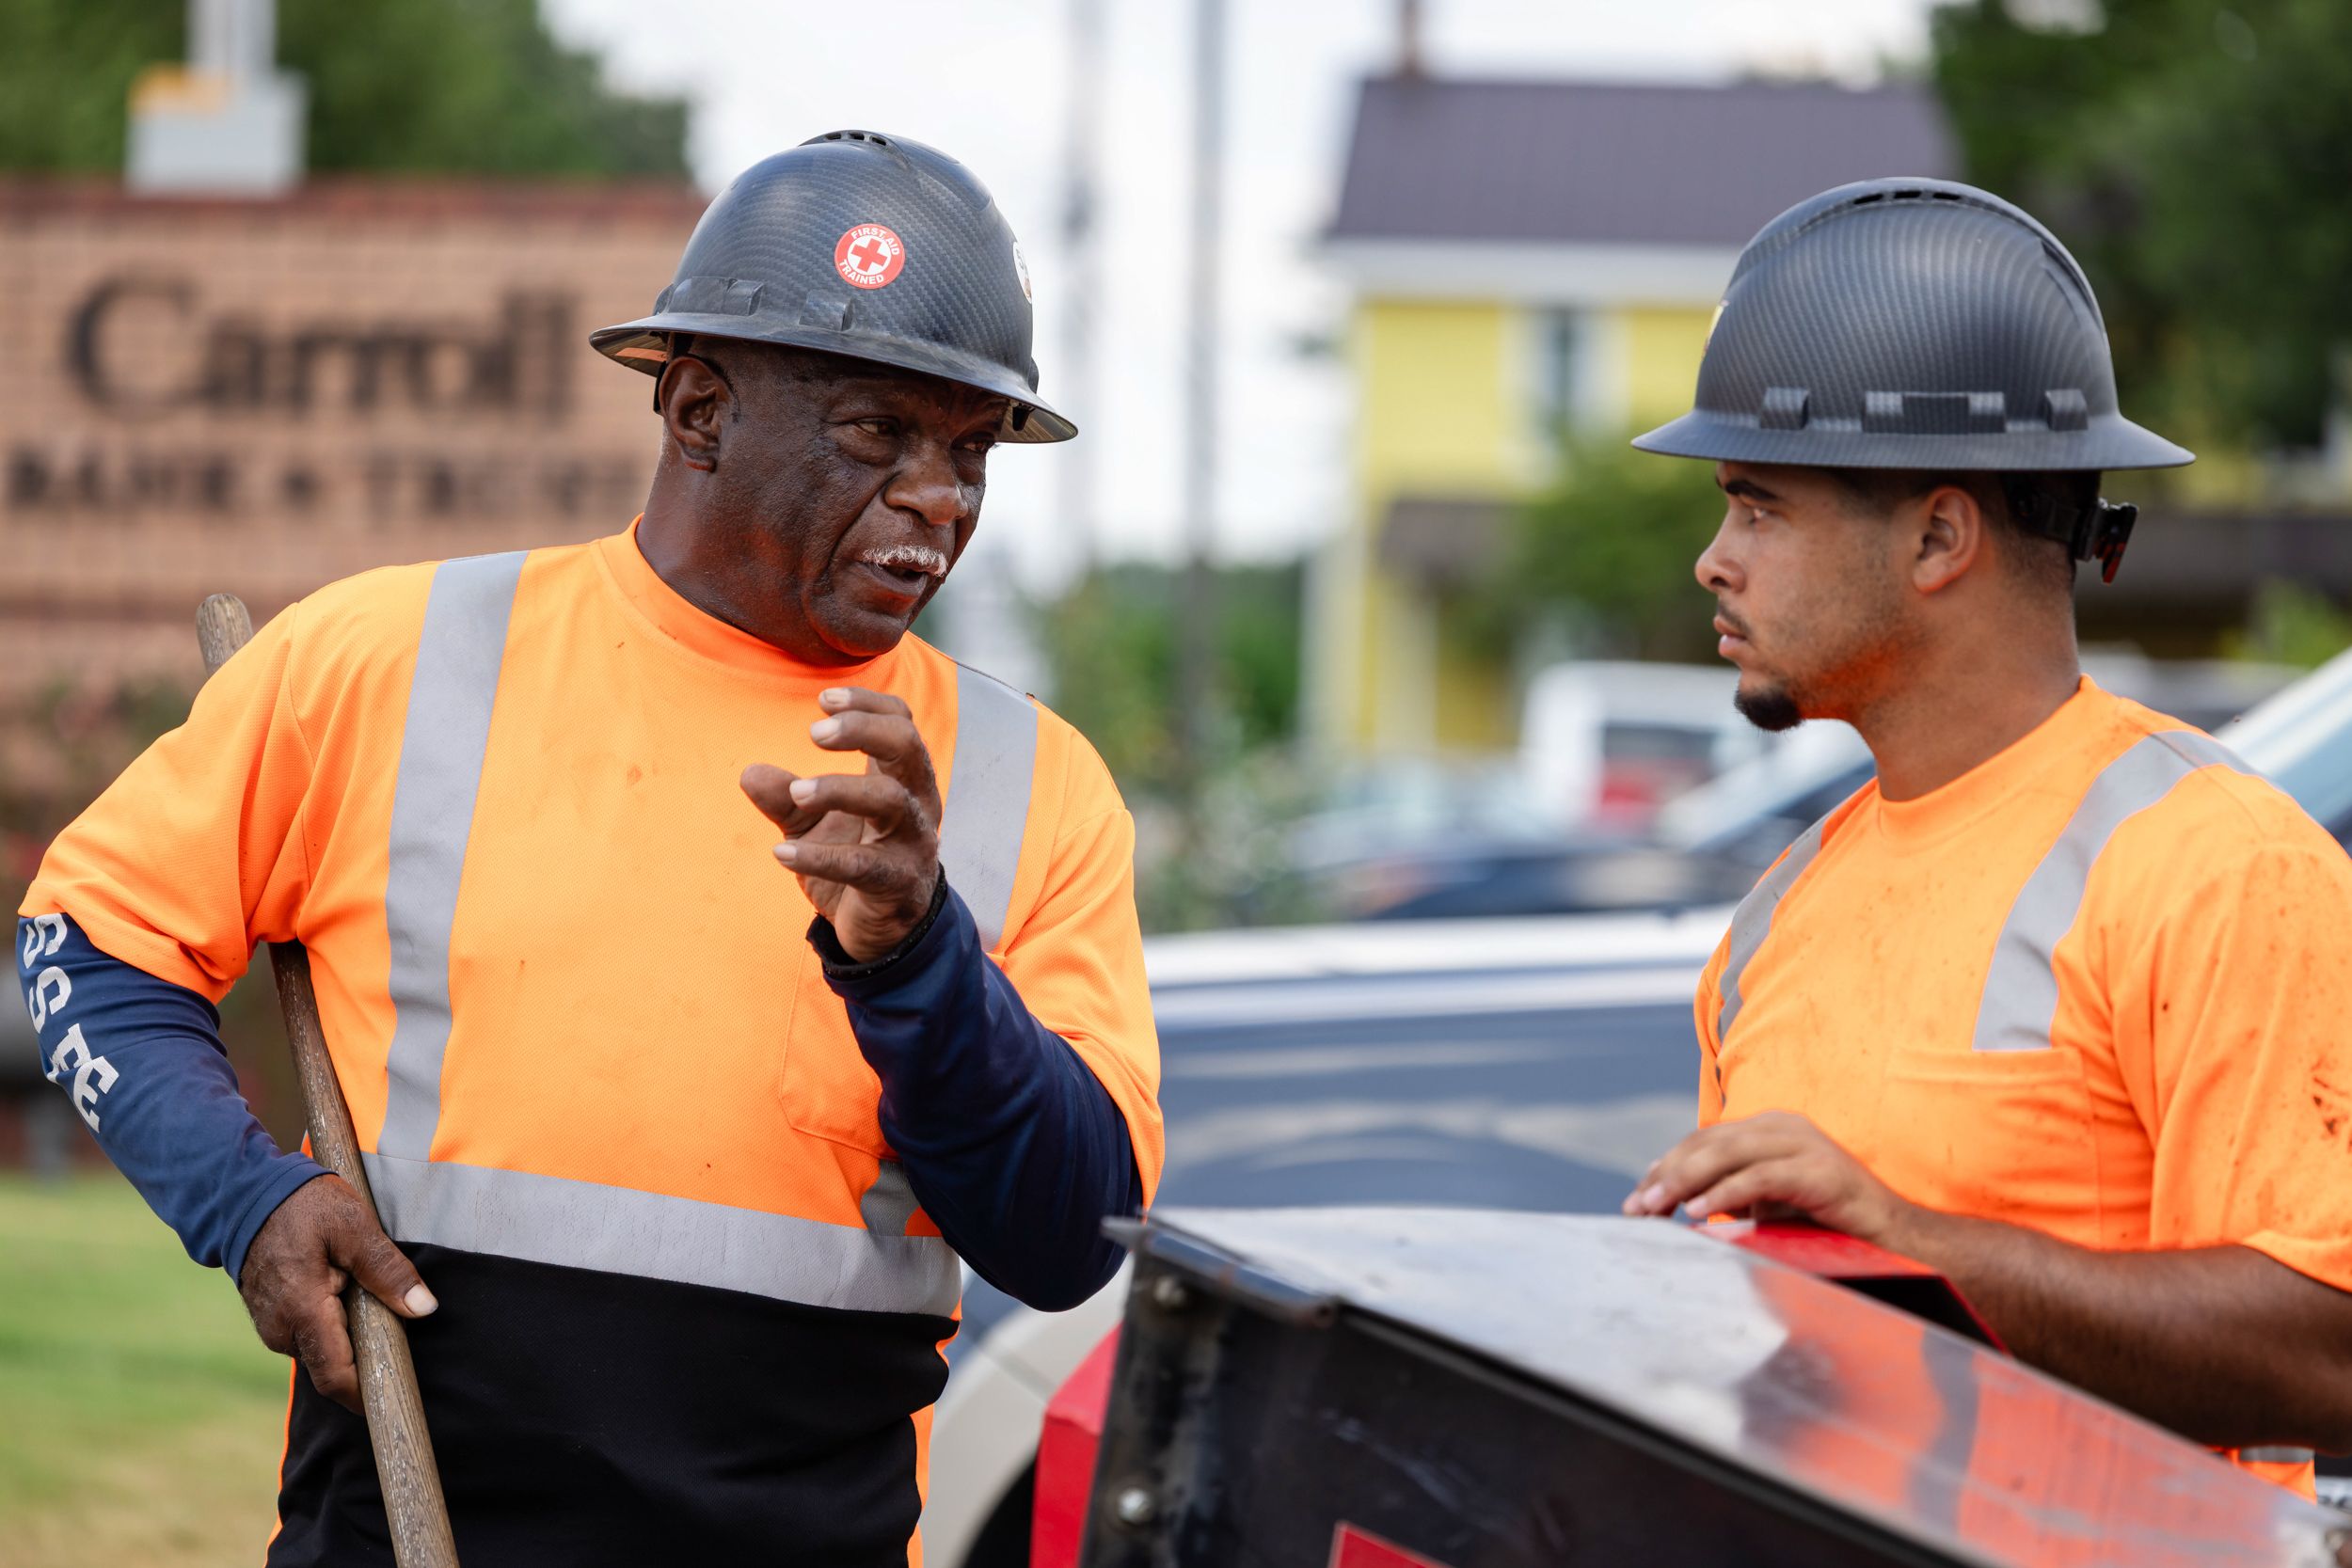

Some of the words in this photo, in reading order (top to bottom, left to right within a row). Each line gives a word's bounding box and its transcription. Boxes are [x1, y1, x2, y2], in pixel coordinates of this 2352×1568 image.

[850, 227, 887, 240] FIRST
[886, 237, 900, 256] AID
[839, 259, 884, 285] TRAINED
[64, 276, 579, 423] Carroll
